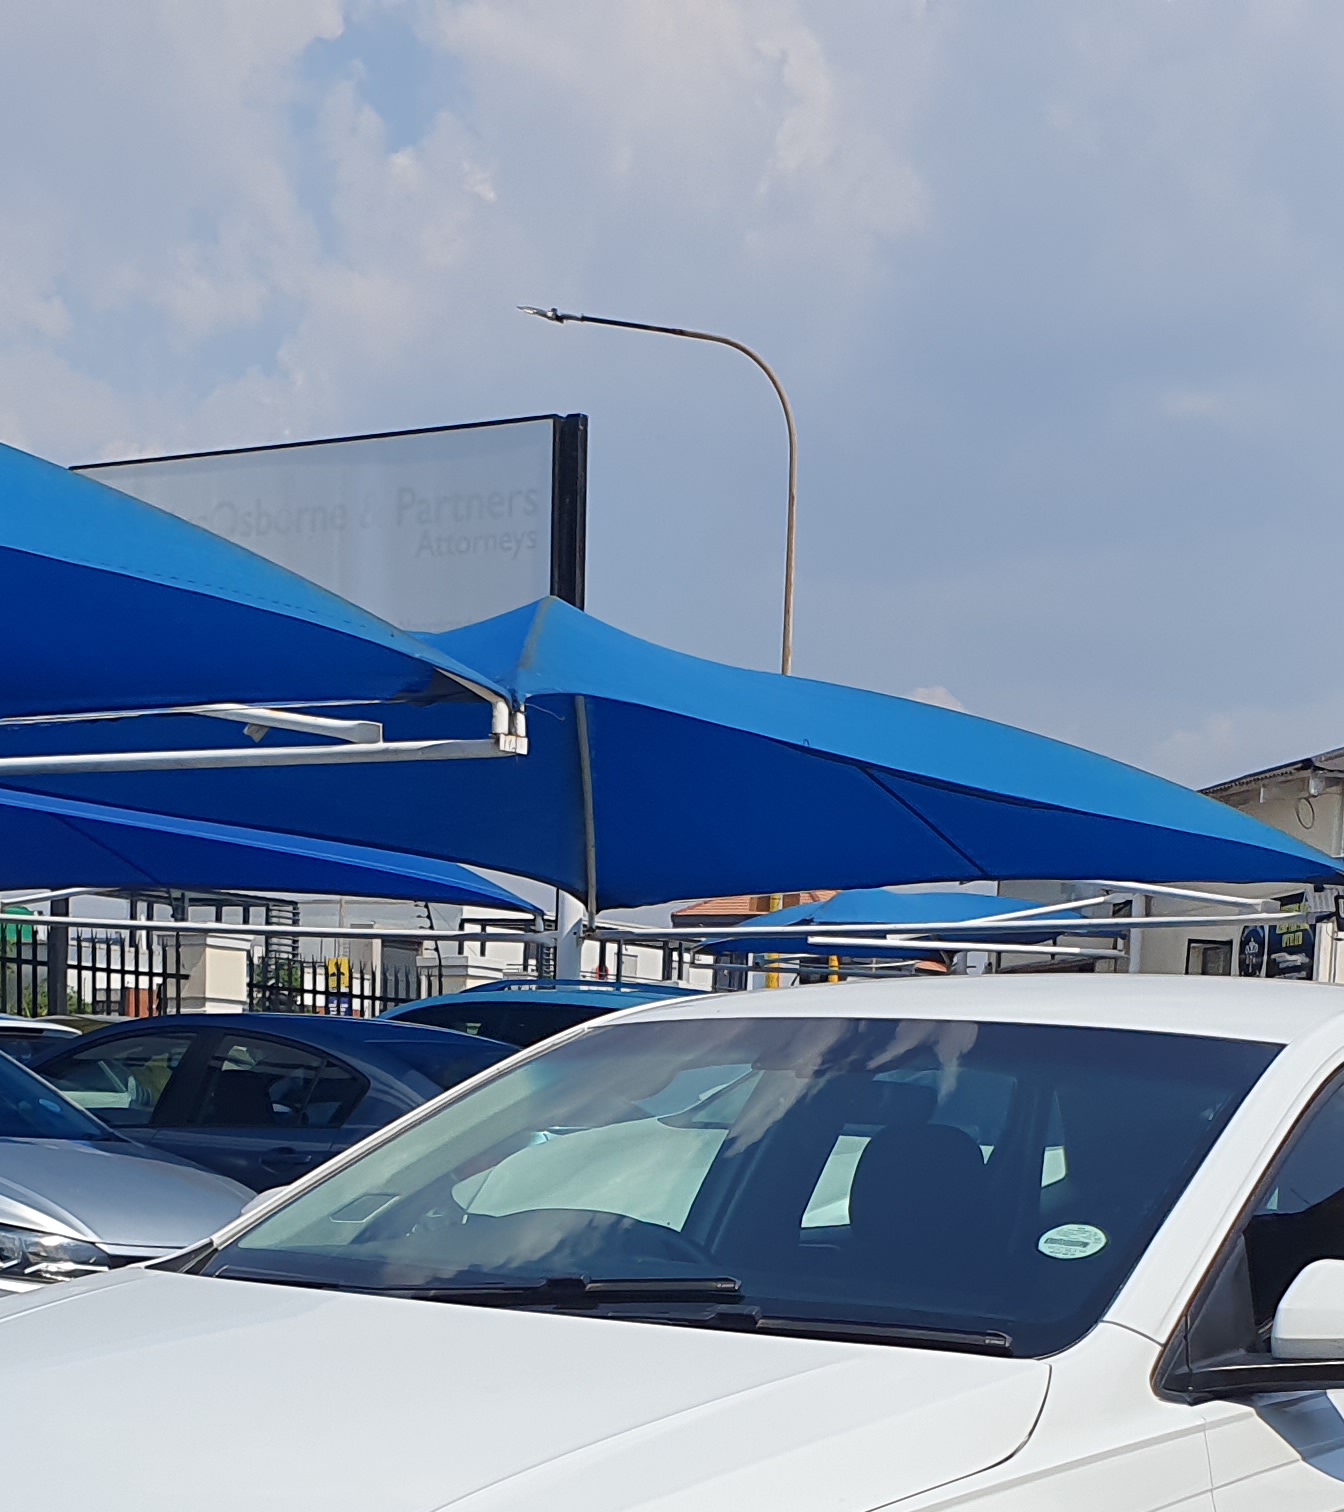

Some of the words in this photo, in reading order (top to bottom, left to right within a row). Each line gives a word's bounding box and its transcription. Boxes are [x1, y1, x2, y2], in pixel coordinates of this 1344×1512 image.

[210, 499, 347, 540] Osborne
[395, 486, 539, 529] Partners
[414, 529, 538, 560] Attorneys
